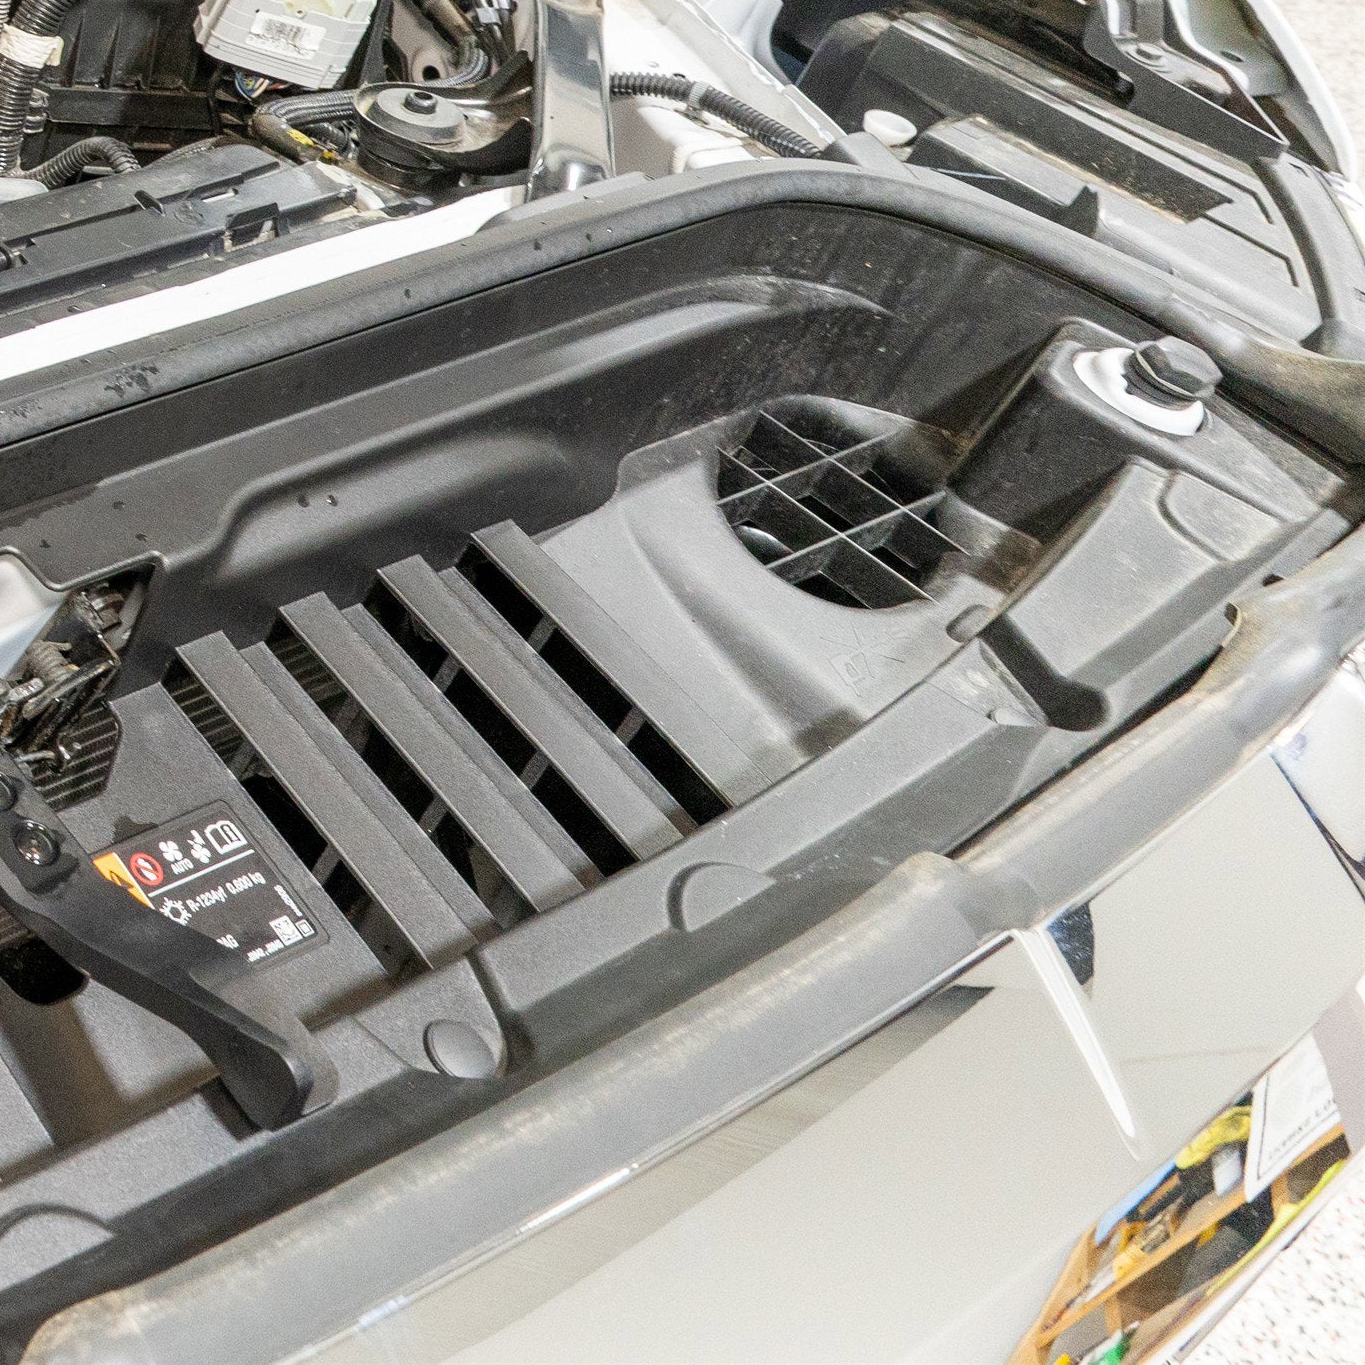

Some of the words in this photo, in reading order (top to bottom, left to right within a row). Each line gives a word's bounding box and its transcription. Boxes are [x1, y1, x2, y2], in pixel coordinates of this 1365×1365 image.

[171, 858, 194, 875] AUTO
[185, 886, 228, 913] R-1234yf
[248, 871, 267, 885] kg
